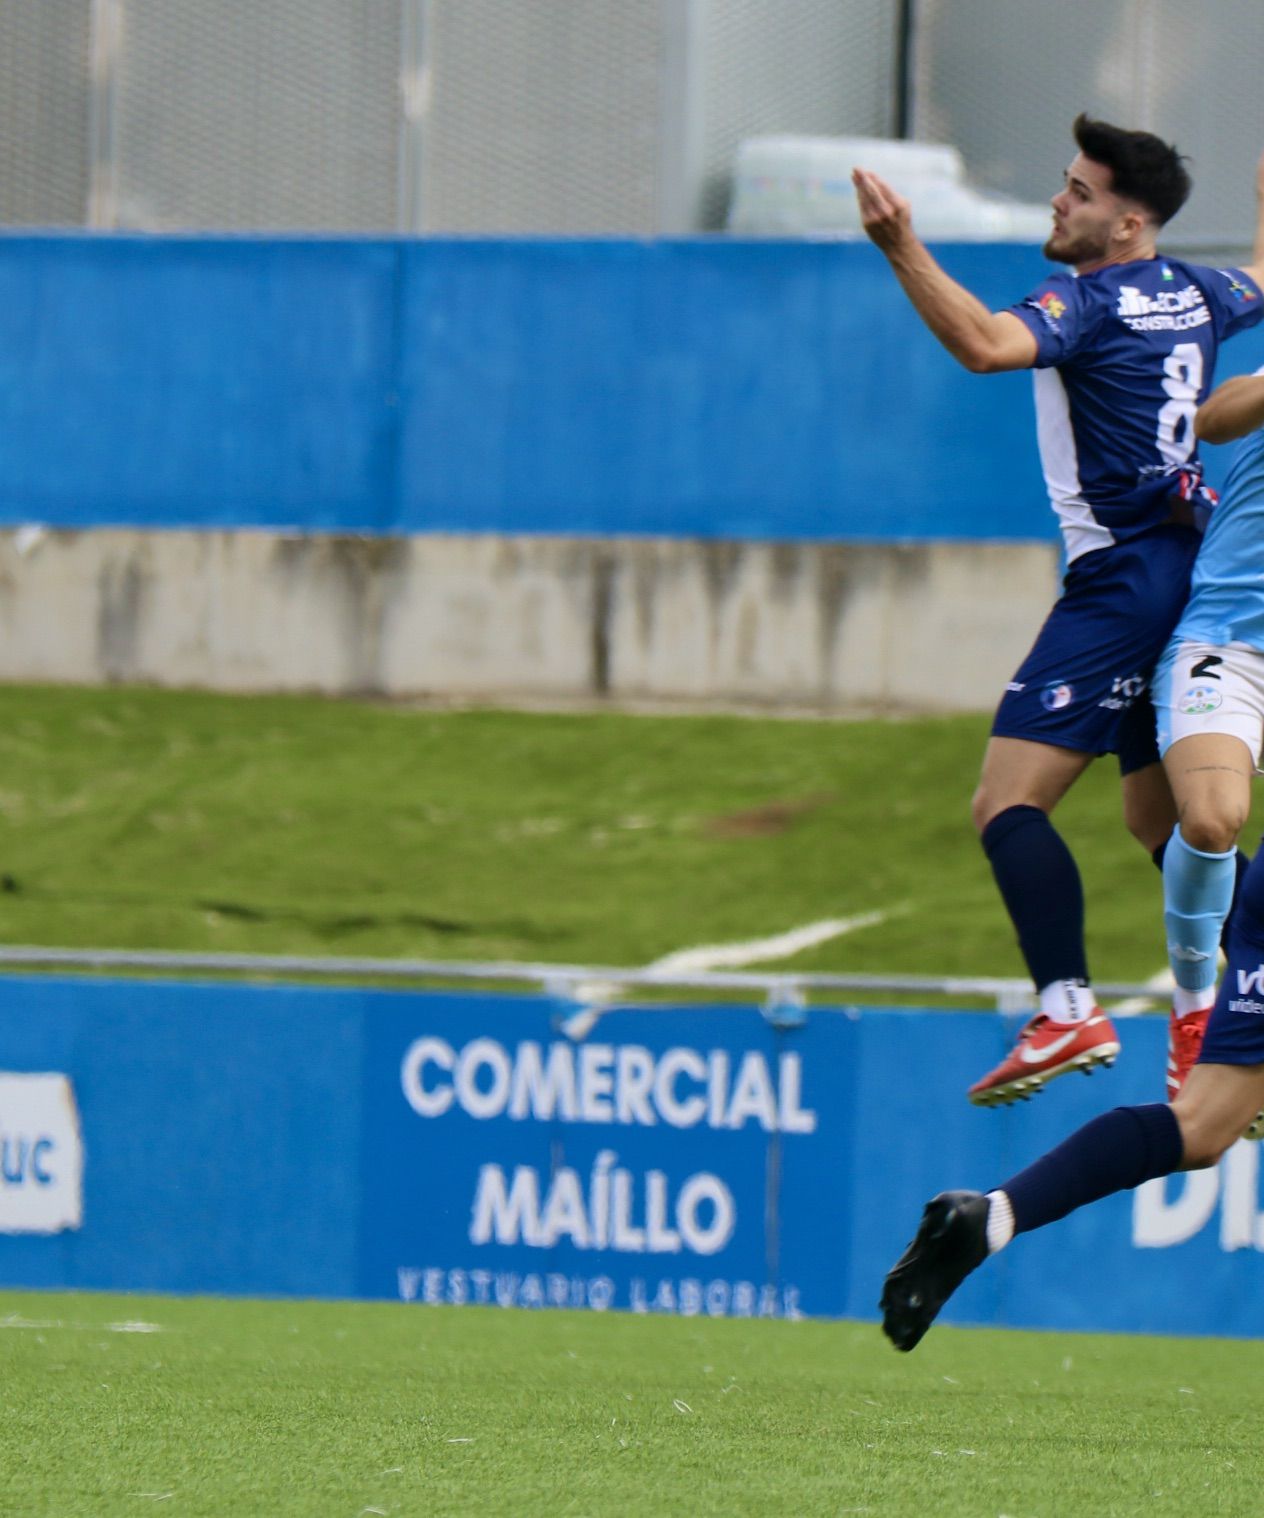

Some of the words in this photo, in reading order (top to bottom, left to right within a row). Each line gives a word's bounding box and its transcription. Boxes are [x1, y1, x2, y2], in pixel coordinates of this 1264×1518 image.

[1155, 343, 1203, 464] 8
[1191, 655, 1223, 680] 2
[402, 1036, 816, 1134] COMERCIAL
[470, 1149, 736, 1255] MAÍLLO
[398, 1266, 616, 1311] VESTUARIO
[630, 1275, 806, 1321] LABORAL
